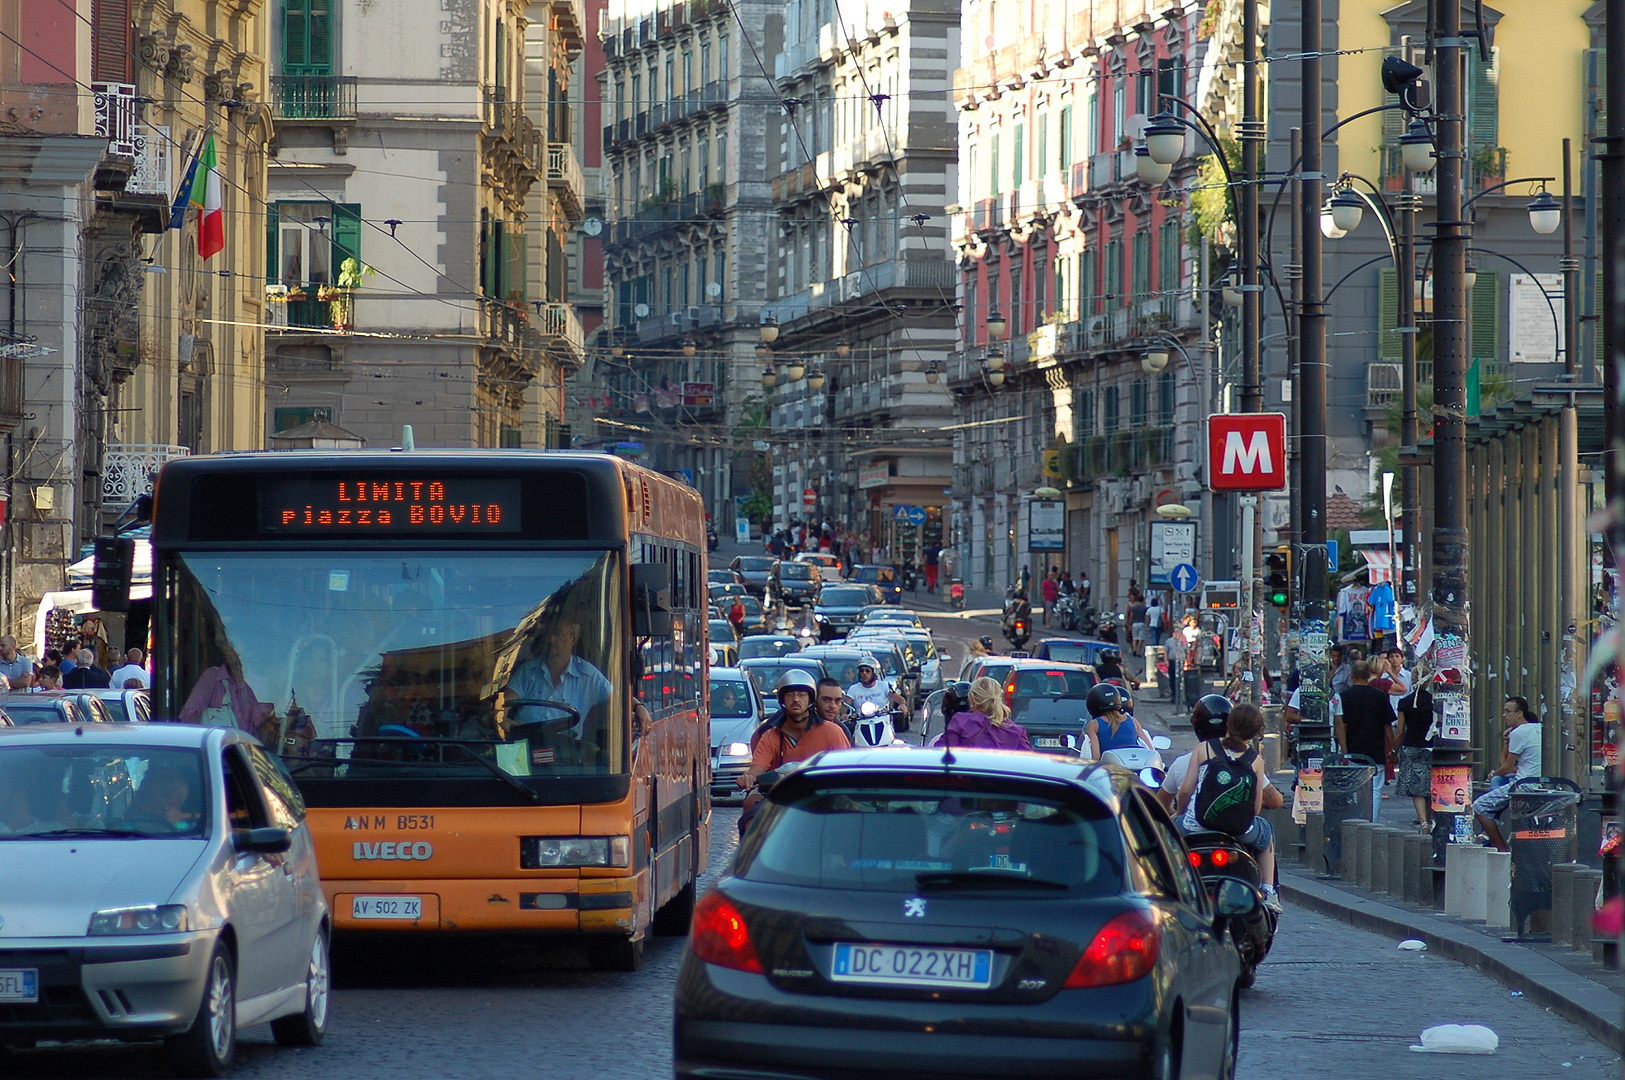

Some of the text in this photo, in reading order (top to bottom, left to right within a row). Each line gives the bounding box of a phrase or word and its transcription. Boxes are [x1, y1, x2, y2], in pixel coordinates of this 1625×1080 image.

[1222, 431, 1273, 474] M
[339, 482, 444, 501] LIMITA
[282, 504, 500, 524] piazza BOVIO
[397, 815, 434, 830] B531
[353, 841, 432, 860] IVECO
[354, 901, 419, 915] AV 502 ZK
[773, 969, 813, 978] PEUGEOT
[853, 949, 973, 979] DC 022XH
[1017, 979, 1046, 990] 207
